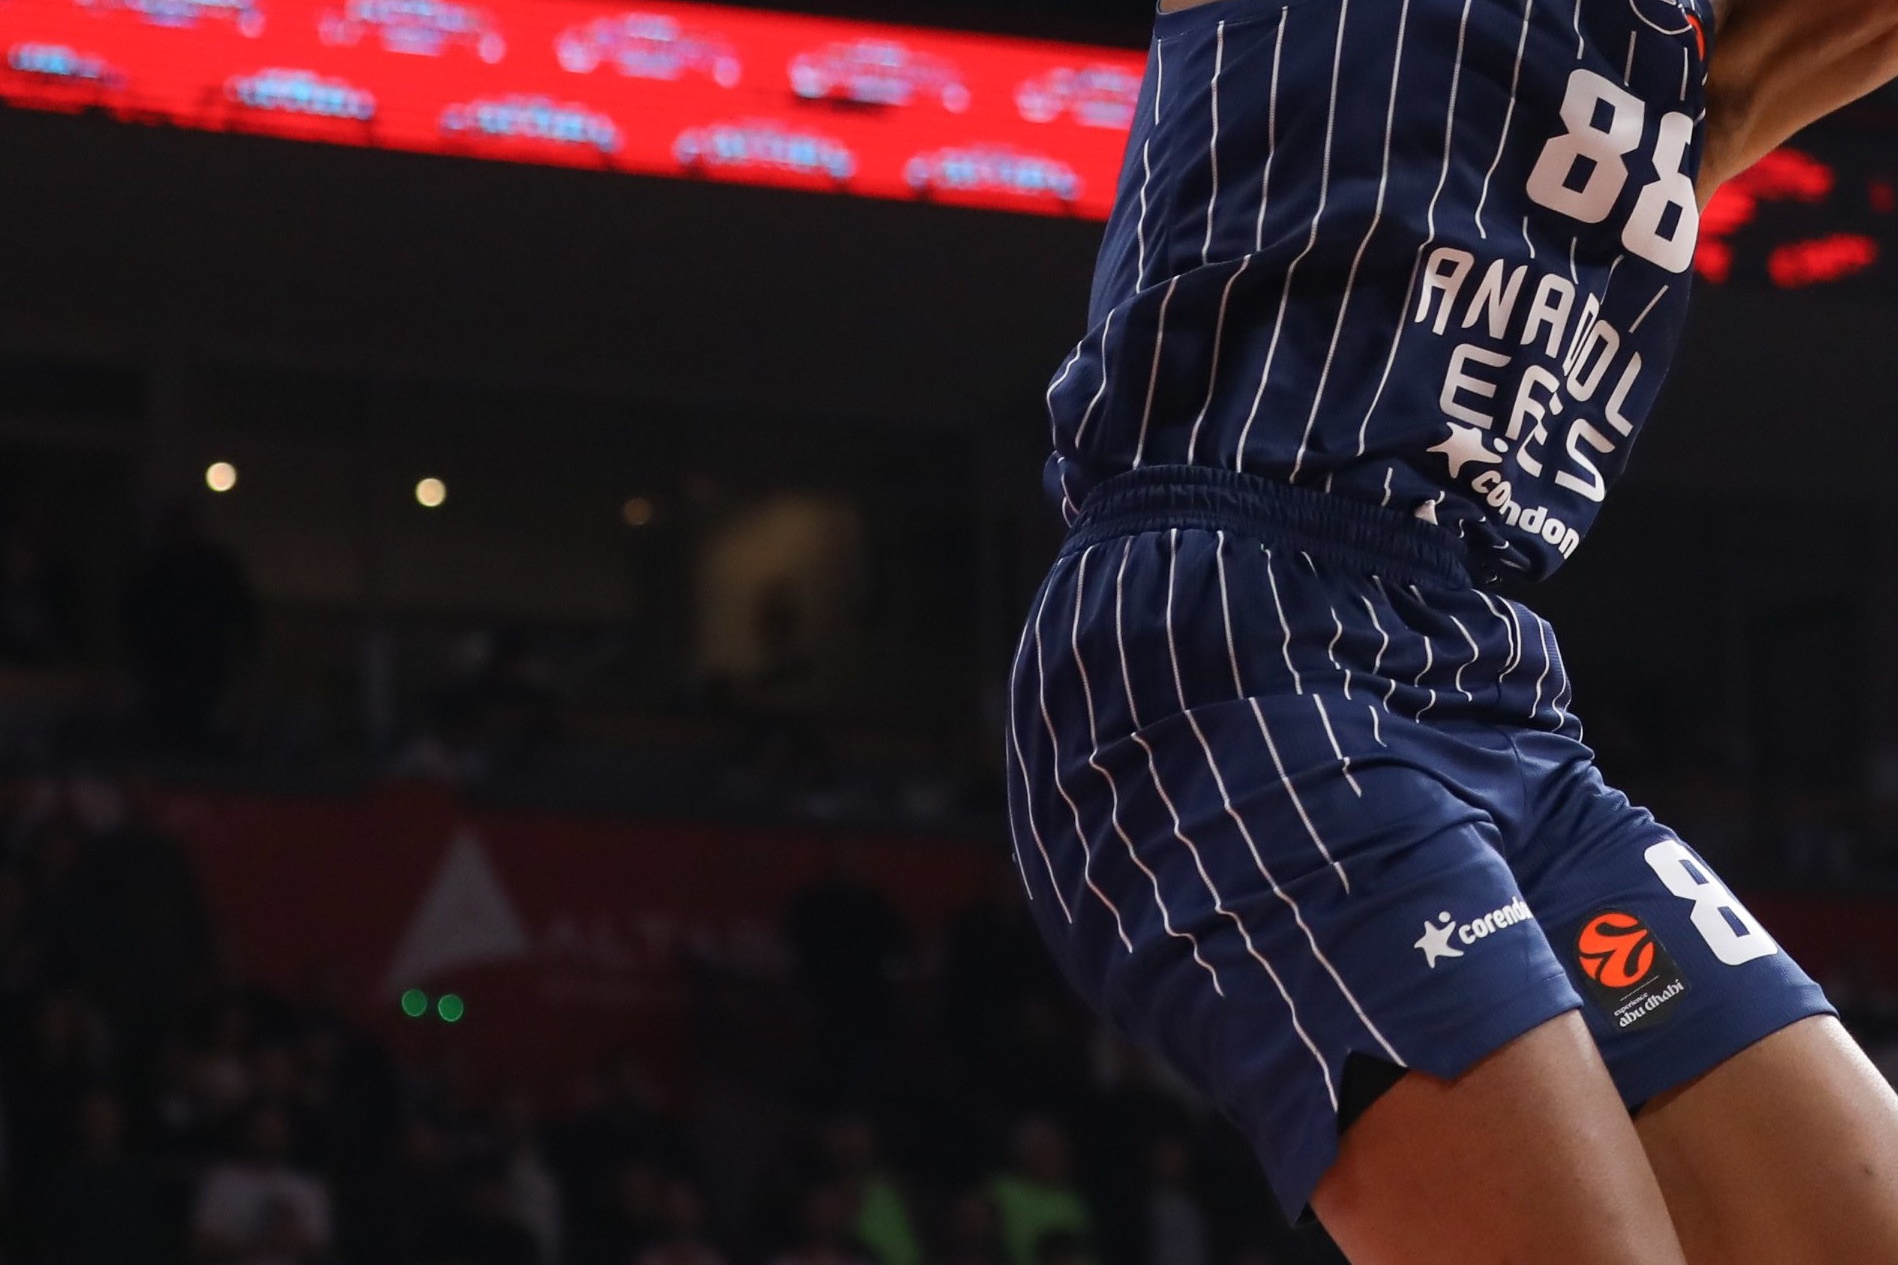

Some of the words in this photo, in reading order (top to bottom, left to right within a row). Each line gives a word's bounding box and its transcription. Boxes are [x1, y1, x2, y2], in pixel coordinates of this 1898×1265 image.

[1526, 68, 1699, 274] 88
[1414, 247, 1641, 437] ANADOL
[1614, 992, 1649, 1017] experience
[1619, 1006, 1647, 1028] abu
[1645, 979, 1684, 1011] dhabi
